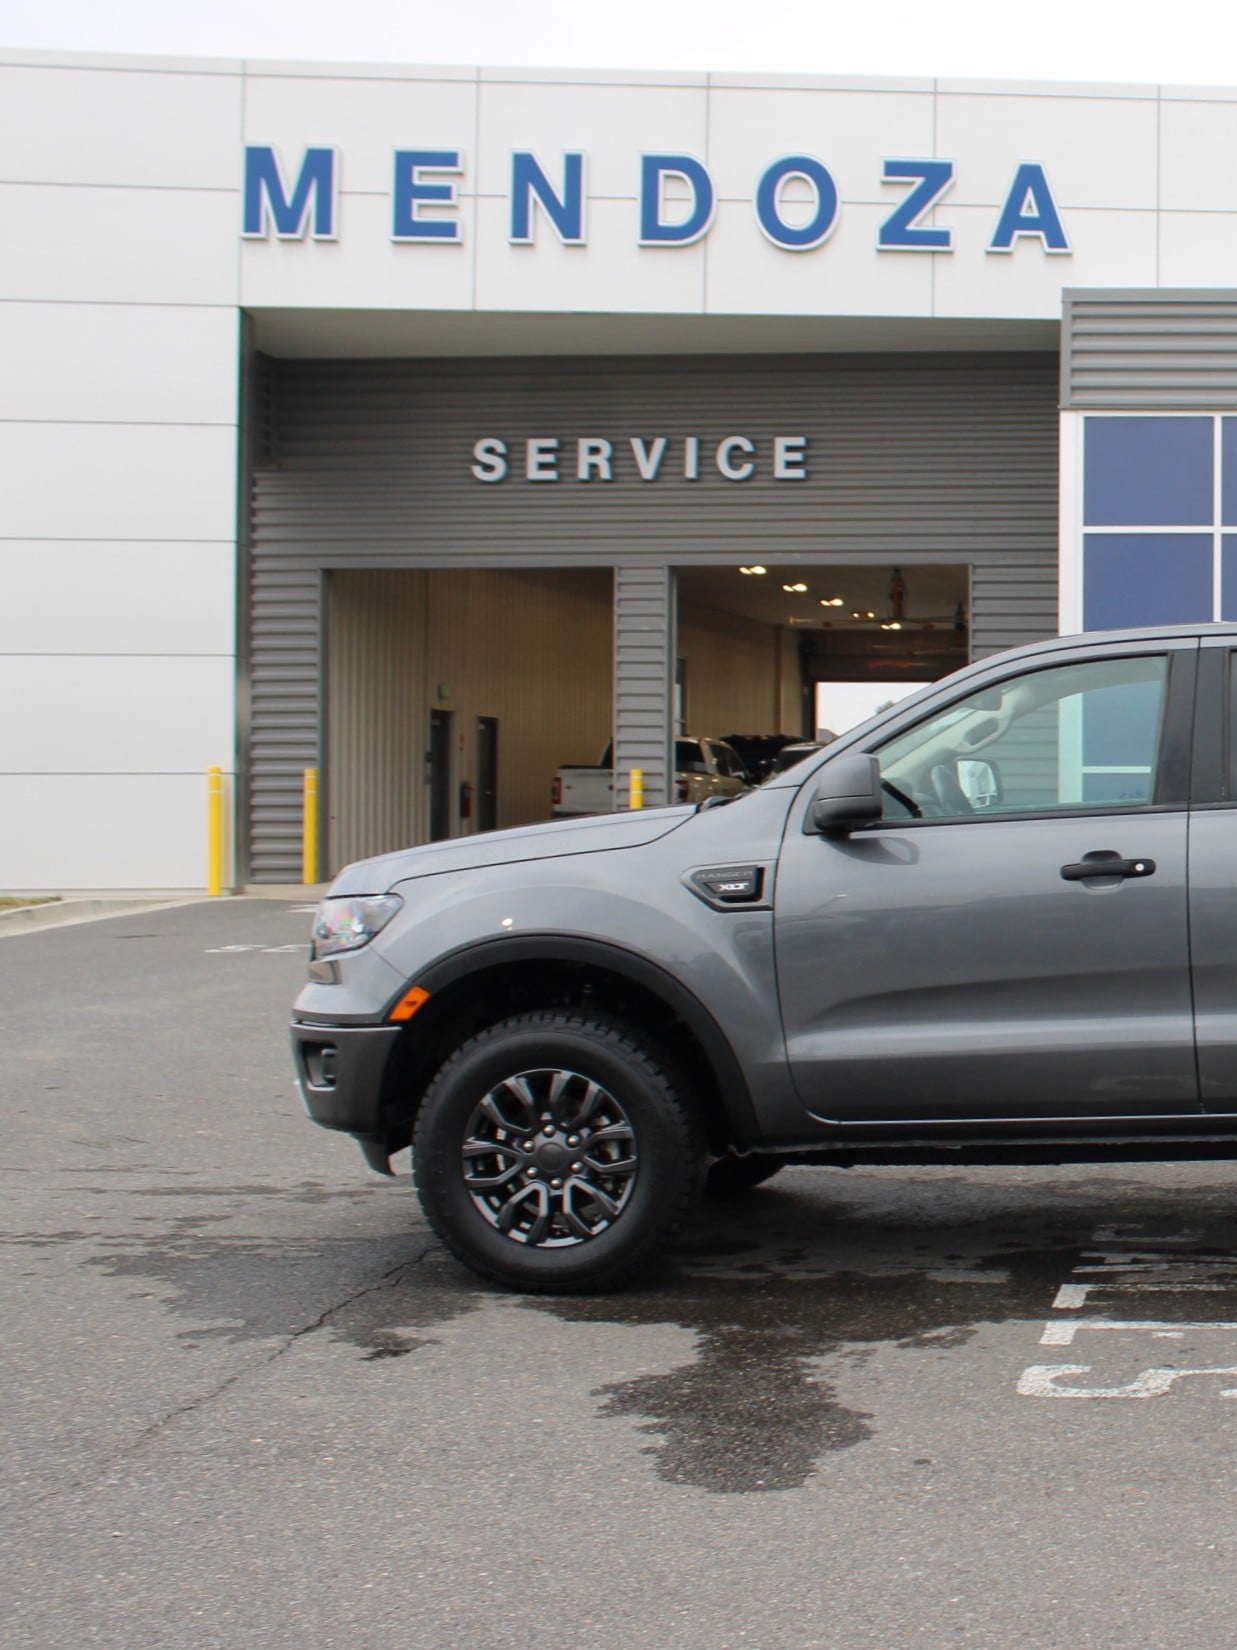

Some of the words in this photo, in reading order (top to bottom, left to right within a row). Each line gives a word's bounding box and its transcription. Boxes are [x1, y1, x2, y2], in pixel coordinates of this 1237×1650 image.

[243, 145, 1073, 253] MENDOZA
[472, 435, 809, 482] SERVICE
[719, 882, 750, 891] XLT
